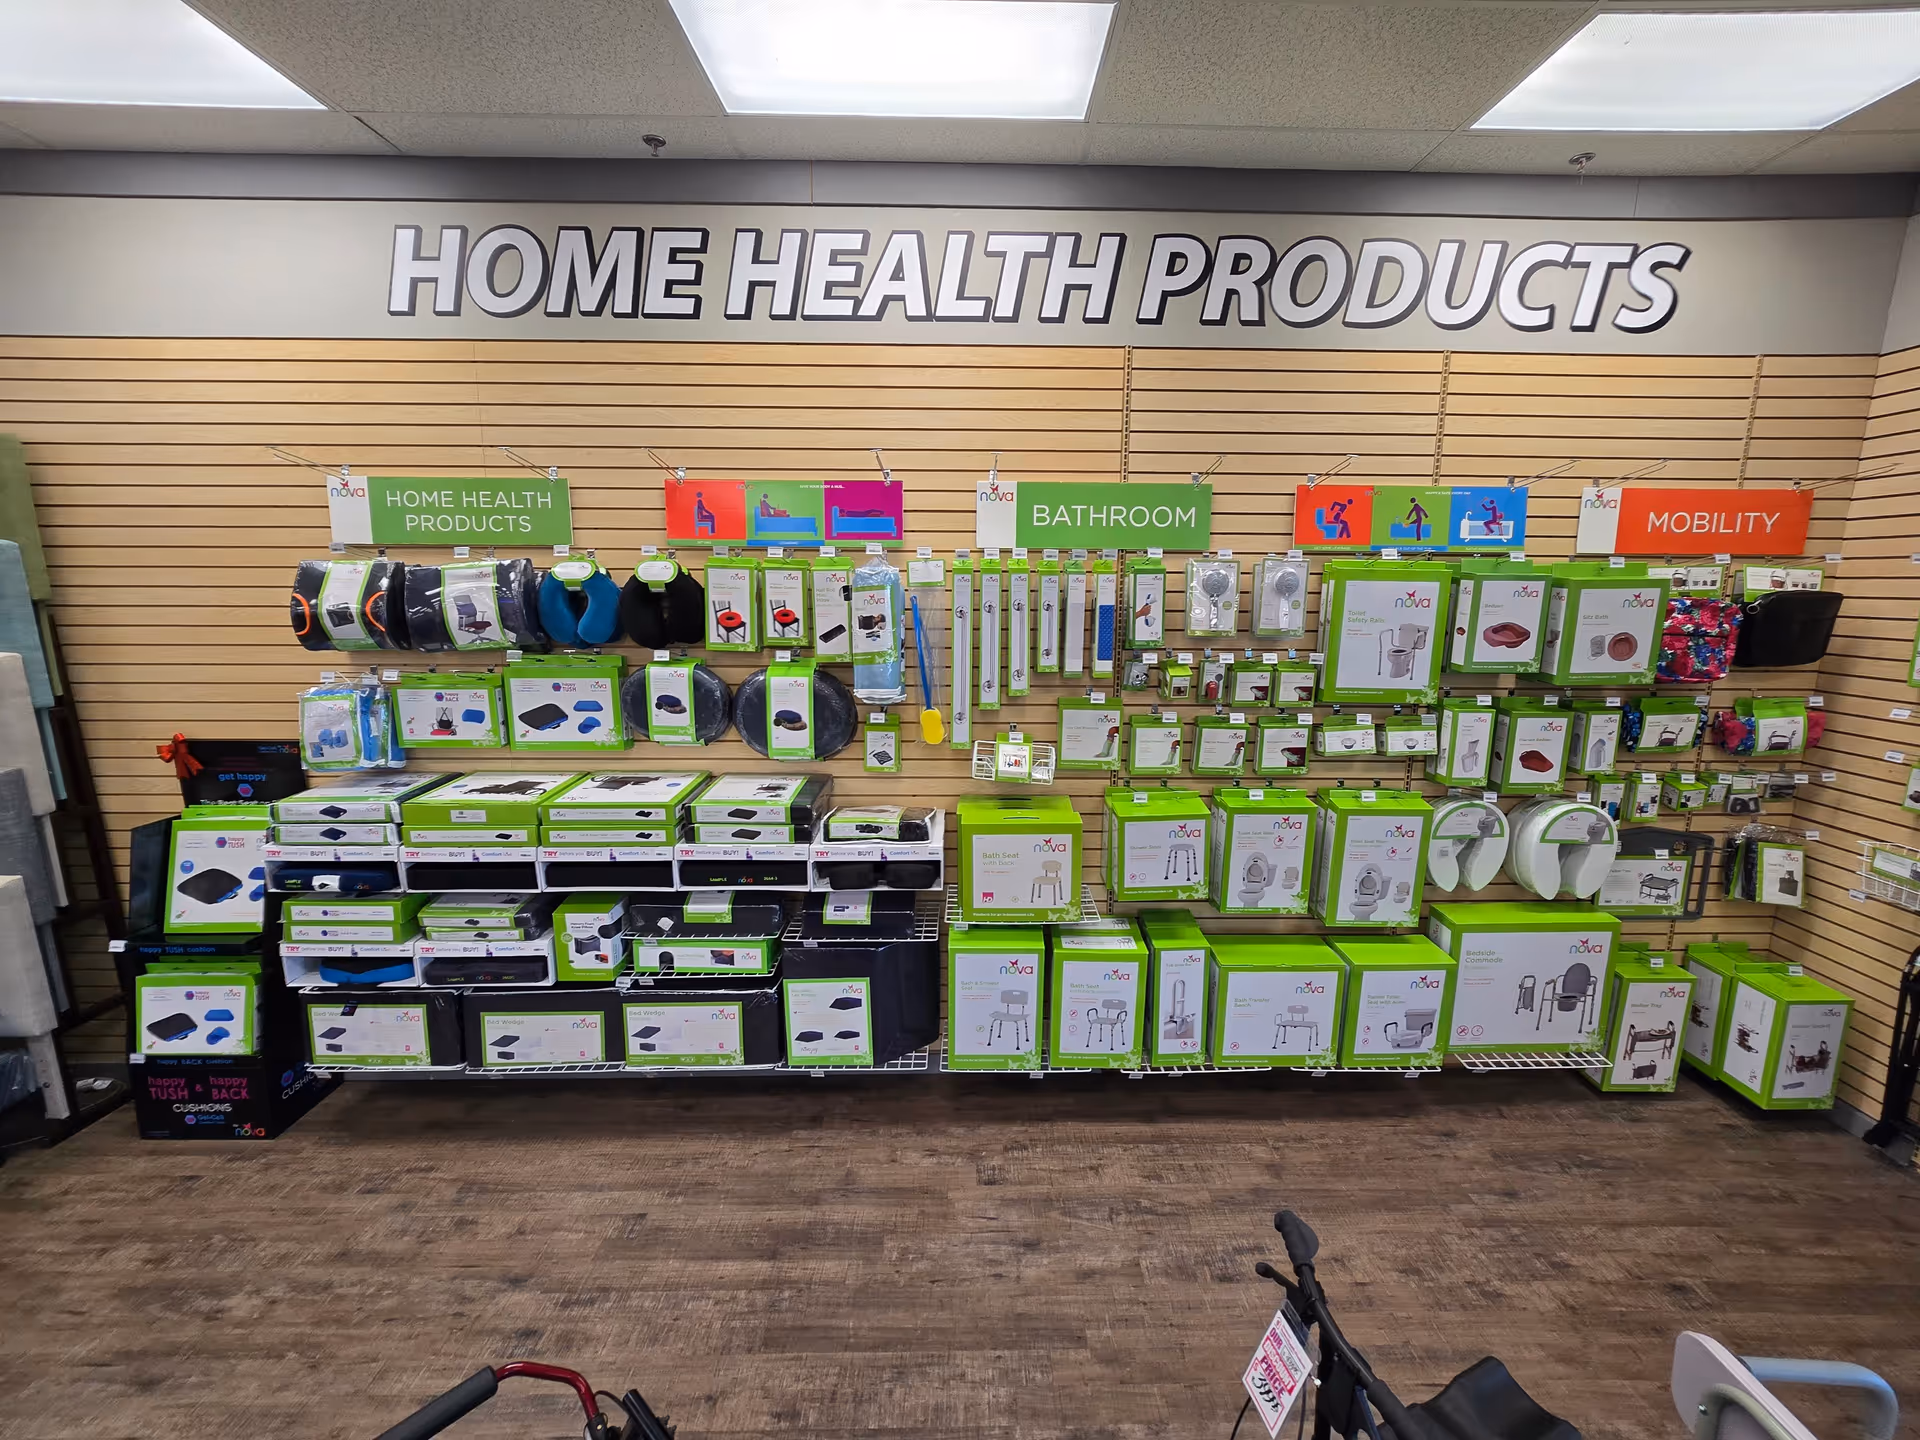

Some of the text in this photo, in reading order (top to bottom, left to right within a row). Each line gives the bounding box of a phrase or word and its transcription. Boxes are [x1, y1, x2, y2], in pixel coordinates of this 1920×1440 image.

[388, 225, 1692, 333] HOME HEALTH PRODUCTS
[331, 487, 365, 498] nova
[980, 491, 1014, 502] nova
[386, 490, 552, 508] HOME HEALTH
[1584, 498, 1617, 509] nova
[1032, 504, 1196, 528] BATHROOM
[406, 514, 532, 532] PRODUCTS
[1648, 512, 1780, 533] MOBILITY
[1514, 590, 1539, 598] nova
[1394, 596, 1431, 608] nova
[1623, 598, 1654, 608] nova
[237, 773, 266, 781] happy
[1273, 821, 1302, 830] nova
[1169, 829, 1201, 838] nova
[1386, 830, 1414, 838] nova
[1034, 844, 1066, 852] nova
[1569, 944, 1602, 954] nova
[1000, 965, 1033, 975] nova
[1104, 973, 1130, 981] nova
[1296, 985, 1324, 994] nova
[1410, 980, 1439, 989] nova
[1660, 990, 1685, 998] nova
[148, 1076, 185, 1088] happy
[209, 1076, 247, 1088] happy
[150, 1088, 249, 1099] TUSH BACK
[173, 1103, 232, 1112] CUSHIONS
[235, 1128, 265, 1136] nova
[1270, 1328, 1283, 1350] OUR
[1260, 1356, 1286, 1398] PRICE
